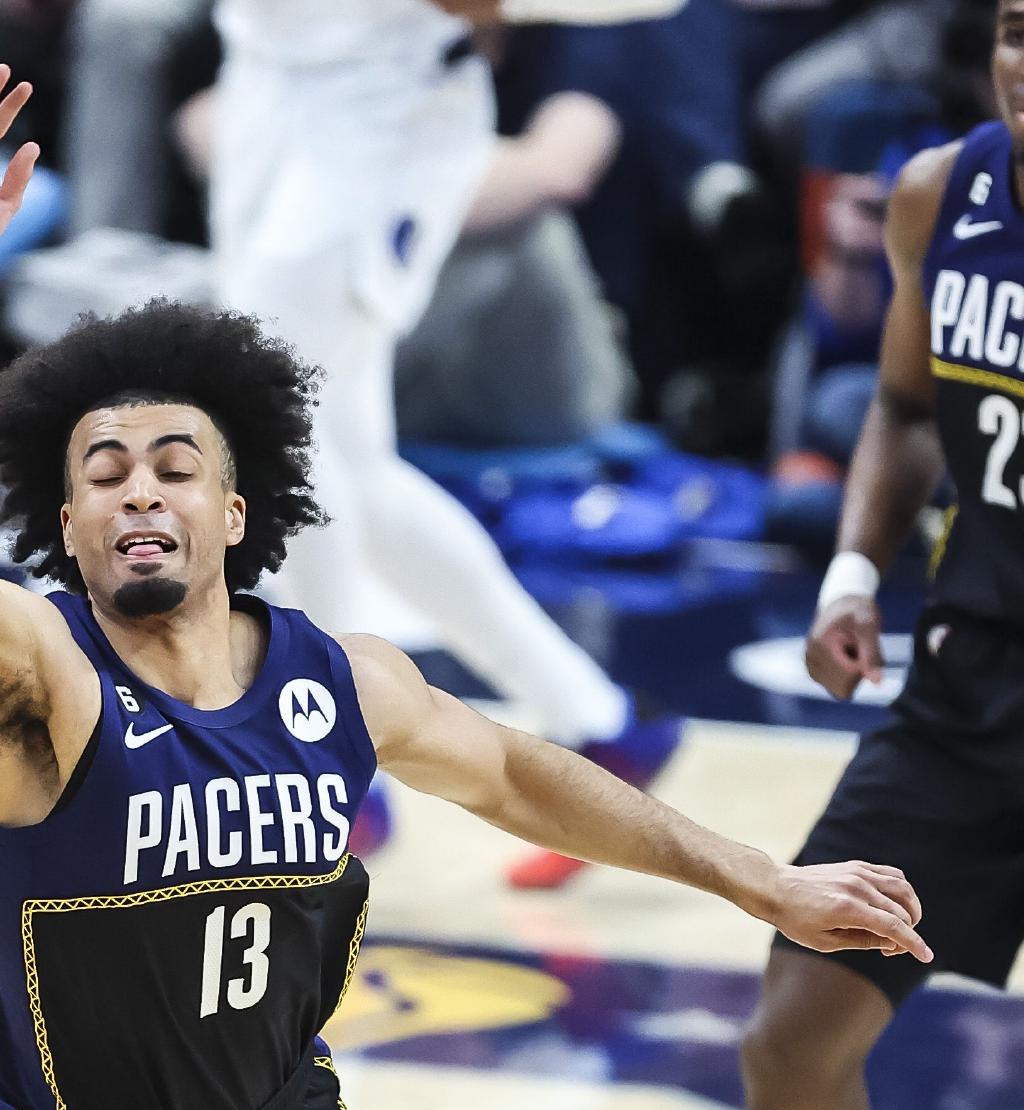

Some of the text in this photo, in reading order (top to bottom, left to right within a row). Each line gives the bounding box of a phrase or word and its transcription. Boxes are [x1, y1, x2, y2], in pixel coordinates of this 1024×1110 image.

[930, 269, 1024, 373] PAC
[978, 394, 1024, 510] 2
[115, 685, 140, 713] 6
[123, 773, 350, 885] PACERS
[199, 902, 272, 1019] 13
